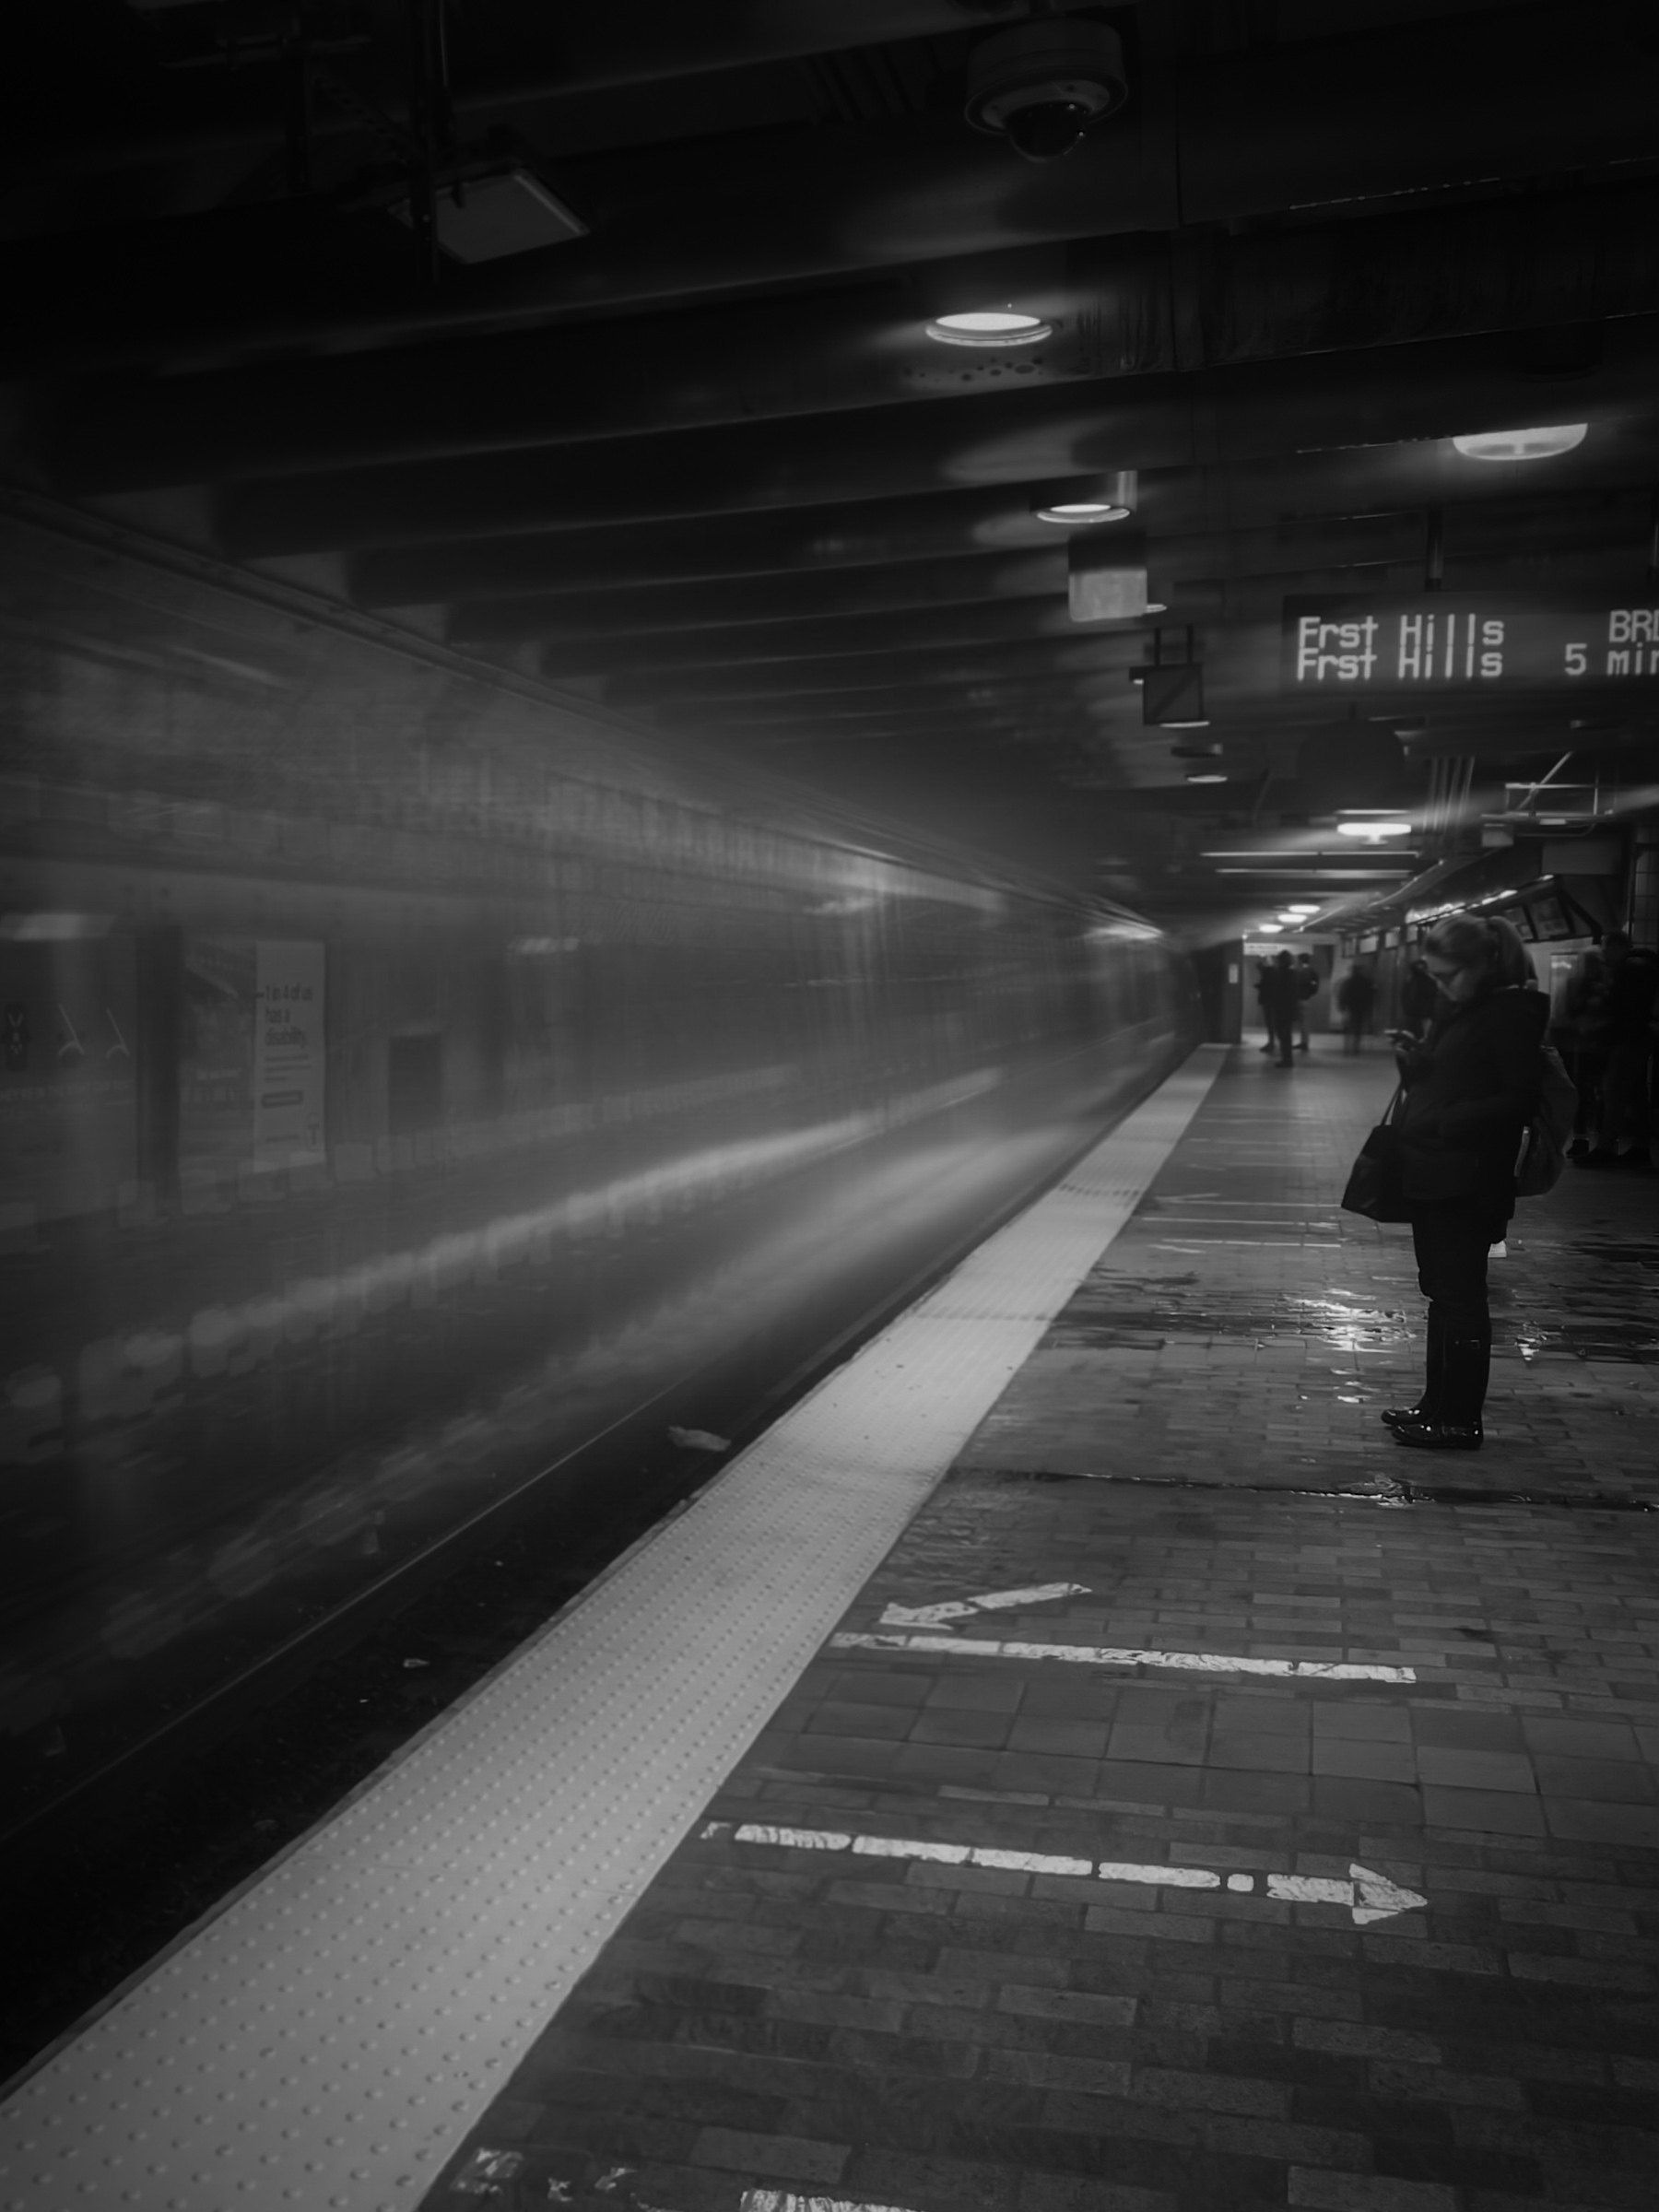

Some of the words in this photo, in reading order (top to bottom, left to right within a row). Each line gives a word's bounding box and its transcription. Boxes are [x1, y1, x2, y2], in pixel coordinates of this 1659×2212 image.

[1399, 613, 1505, 649] Hills
[1297, 647, 1378, 681] Frst
[1398, 644, 1504, 680] Hills
[1564, 641, 1587, 677] 5
